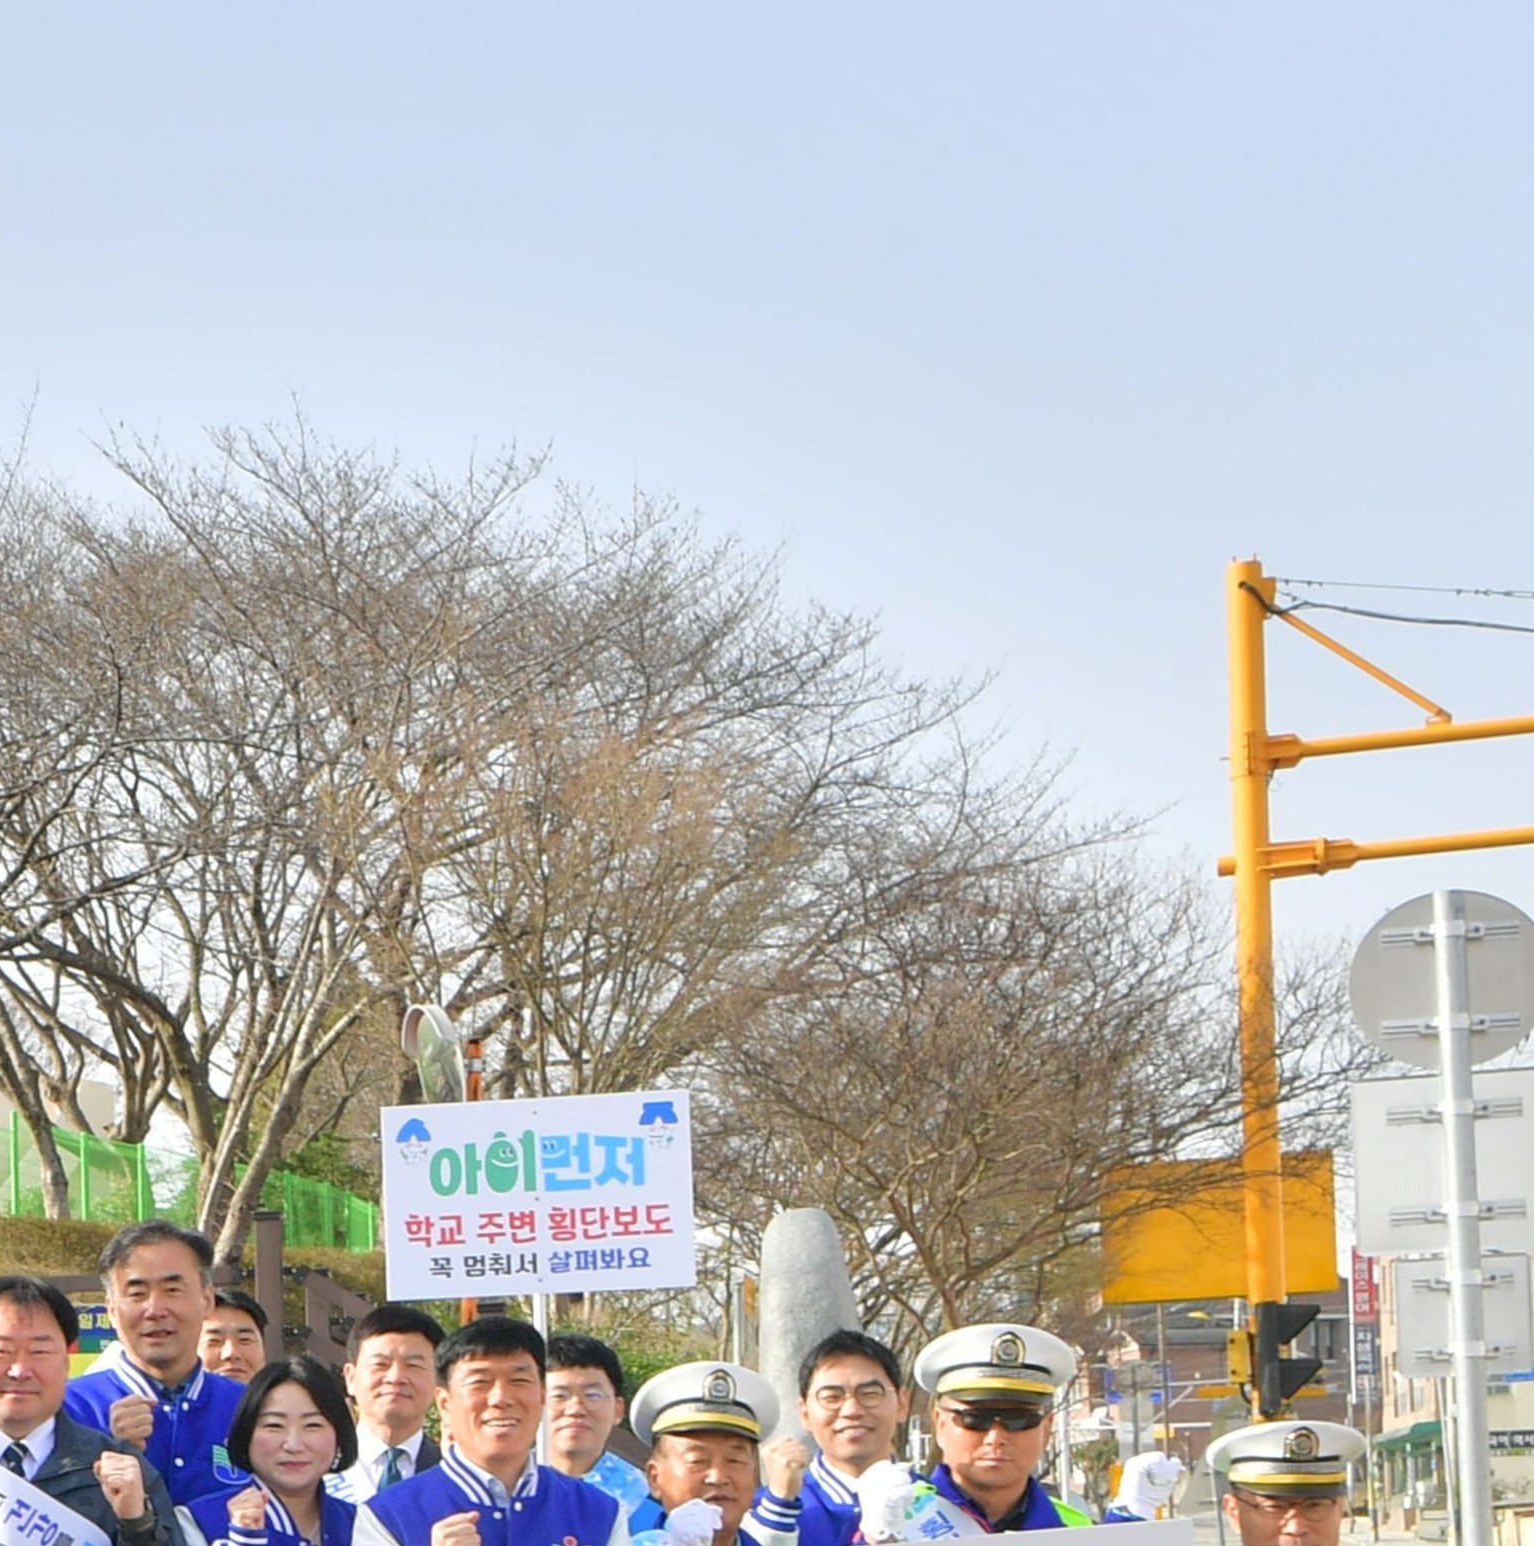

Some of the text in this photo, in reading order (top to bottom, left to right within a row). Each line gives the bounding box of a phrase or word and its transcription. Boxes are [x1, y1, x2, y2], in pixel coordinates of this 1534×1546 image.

[429, 1130, 646, 1196] 아이먼저
[405, 1204, 673, 1247] 학교 주변 횡단보도
[429, 1247, 651, 1278] 꼭 멈춰서 살펴봐요
